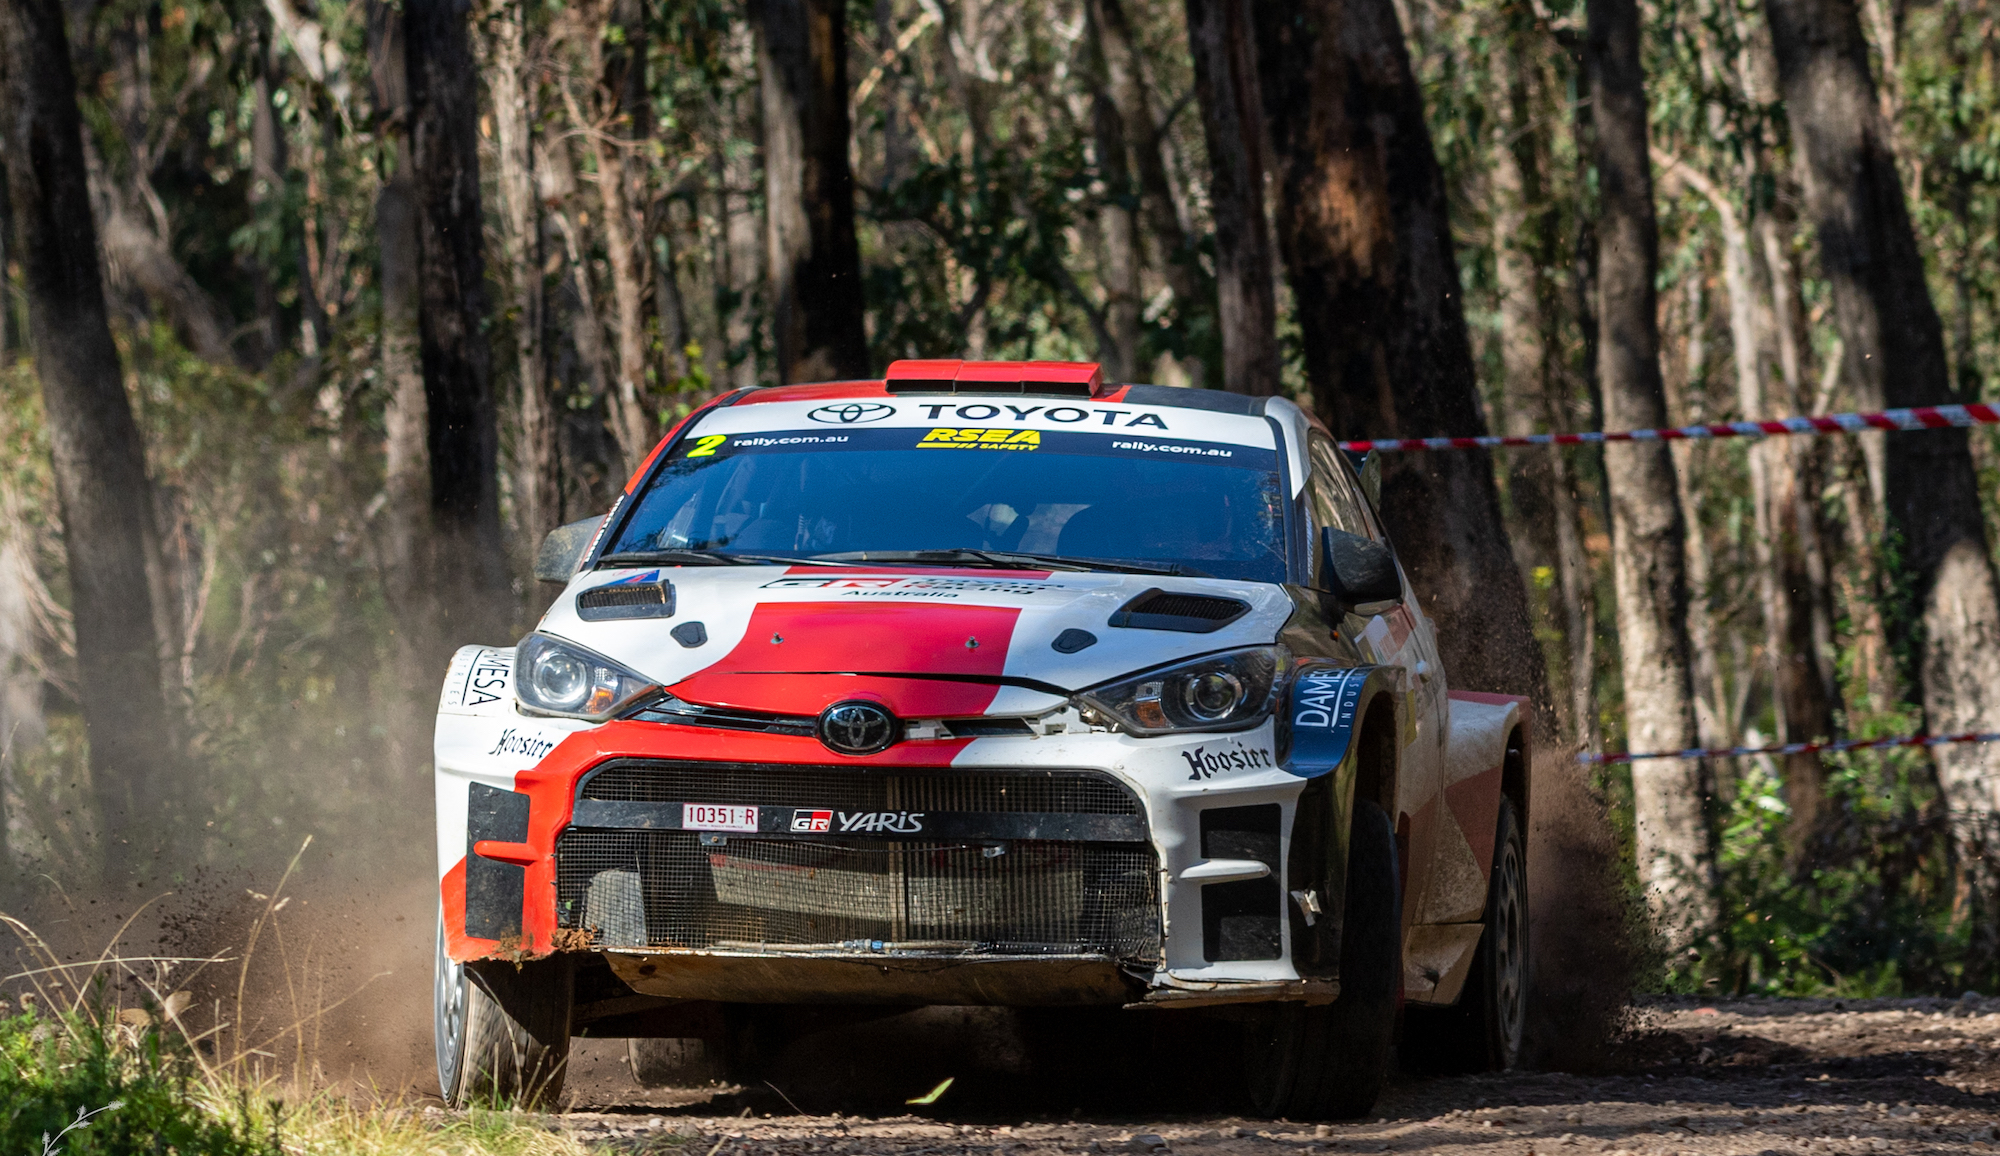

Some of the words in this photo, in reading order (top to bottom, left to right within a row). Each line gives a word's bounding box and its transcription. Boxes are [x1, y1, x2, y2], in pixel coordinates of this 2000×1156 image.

[919, 404, 1169, 430] TOYOTA
[733, 435, 849, 447] rally.com.au
[922, 428, 1041, 444] RSEA
[687, 434, 727, 458] 2
[979, 443, 1039, 451] SAFETY
[1112, 439, 1233, 458] rally.com.au
[842, 590, 959, 598] Australia
[488, 728, 554, 759] Hoosier
[1181, 741, 1271, 781] Hoosier
[793, 817, 830, 830] GR
